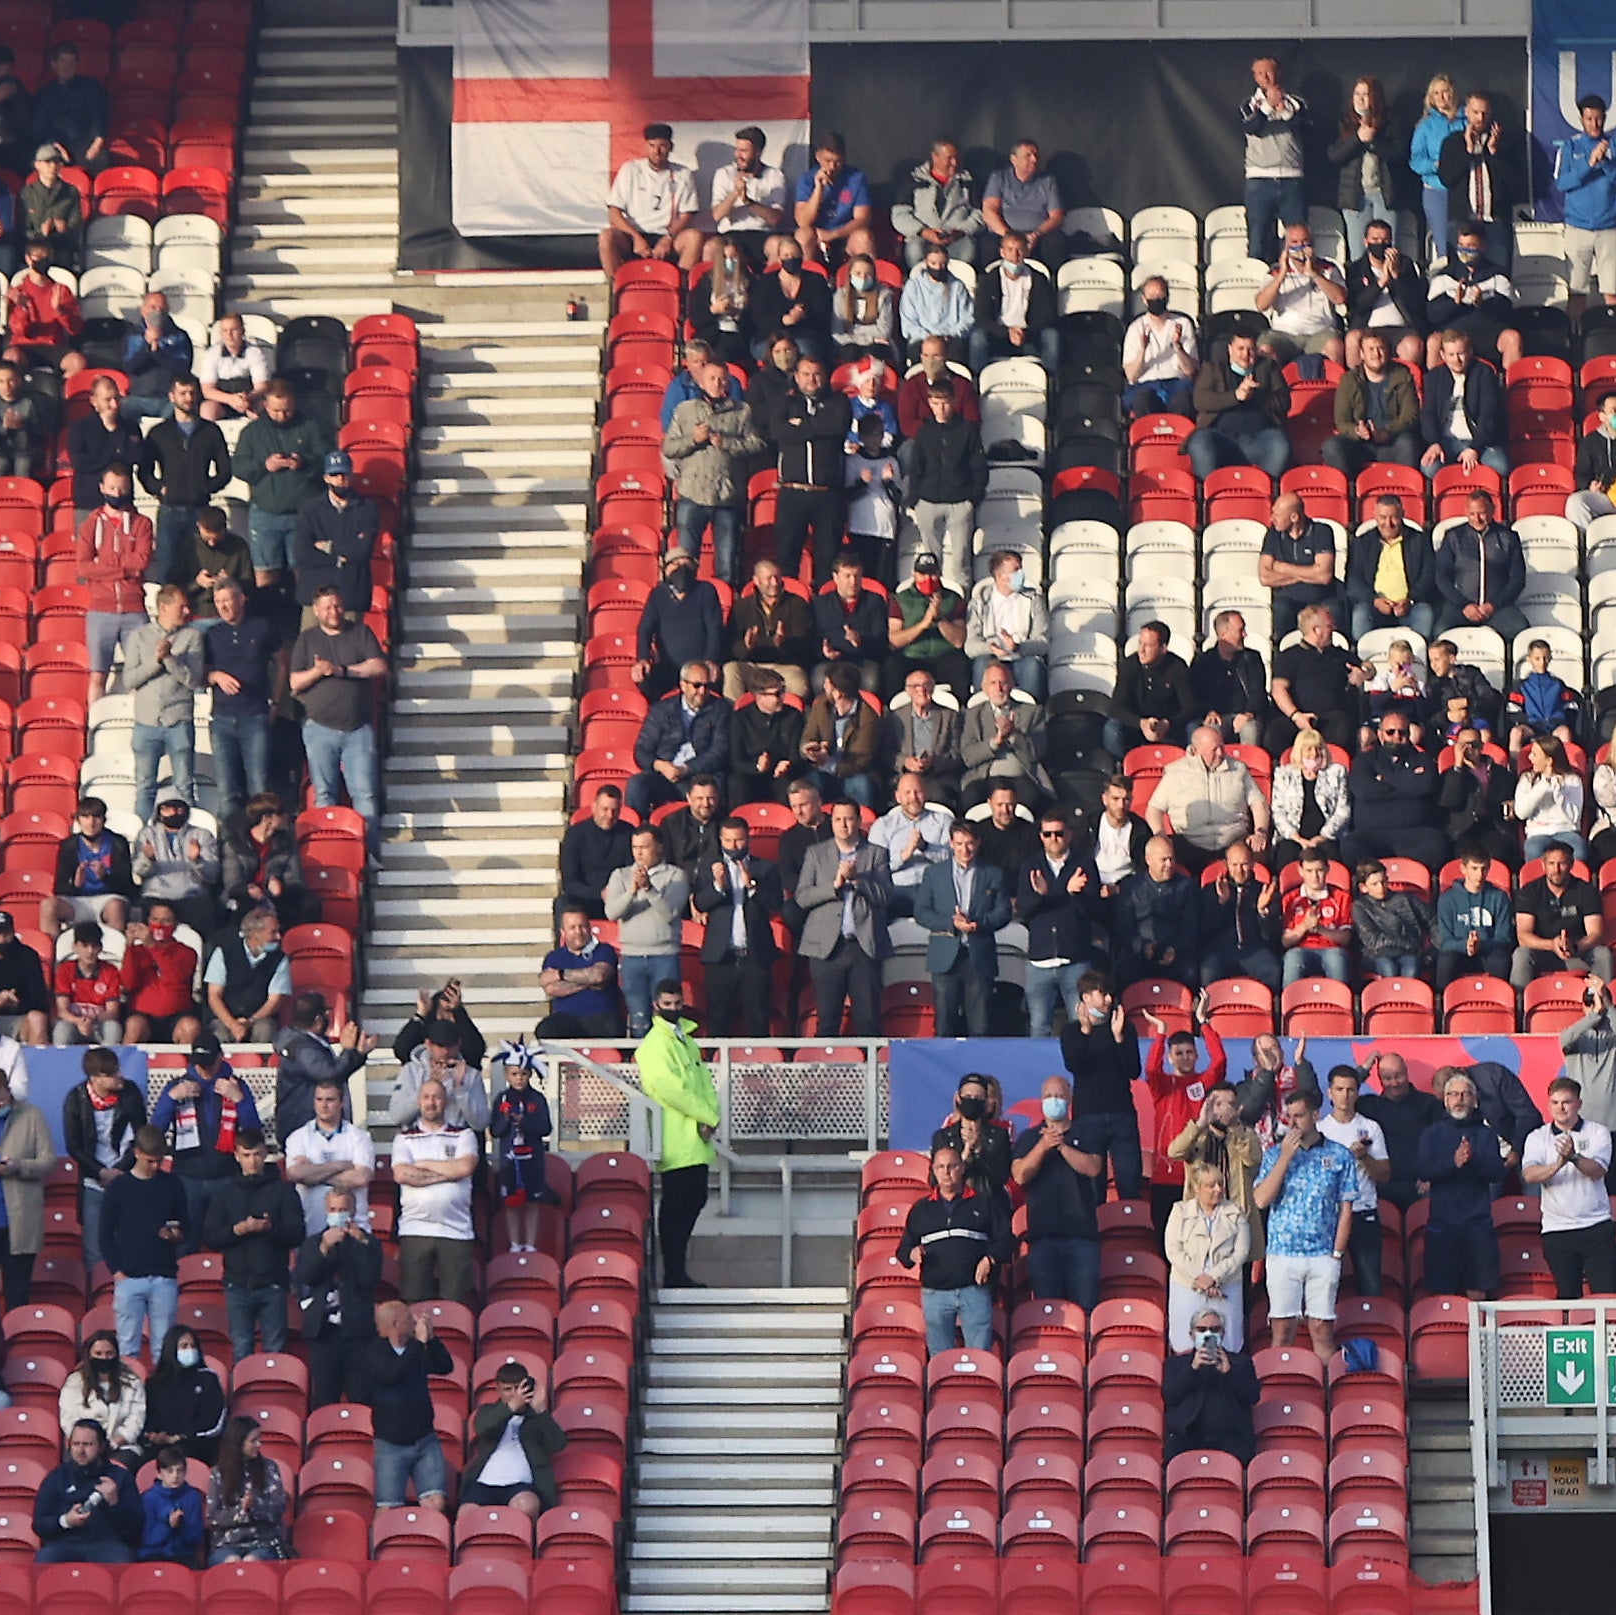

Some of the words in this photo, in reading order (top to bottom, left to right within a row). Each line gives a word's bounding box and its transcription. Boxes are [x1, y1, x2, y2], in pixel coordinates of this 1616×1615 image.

[1553, 1338, 1588, 1354] Exit
[1554, 1477, 1579, 1485] YOUR
[1554, 1488, 1579, 1496] HEAD
